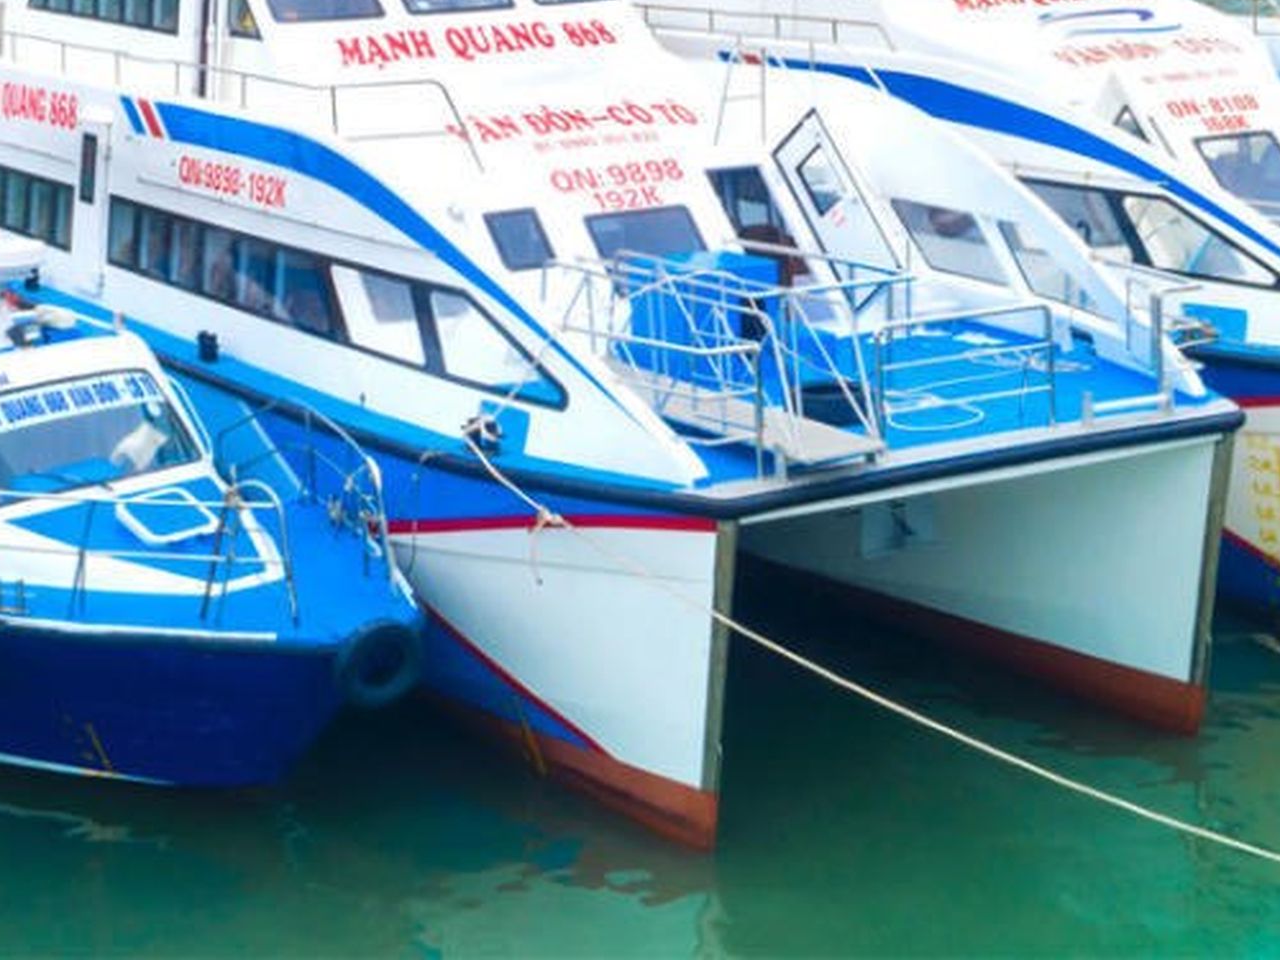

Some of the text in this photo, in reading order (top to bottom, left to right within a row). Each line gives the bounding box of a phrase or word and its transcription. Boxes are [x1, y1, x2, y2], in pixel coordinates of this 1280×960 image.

[336, 19, 618, 70] MẠNH QUANG 868
[1, 81, 48, 122] QUANG
[593, 185, 664, 211] 192K
